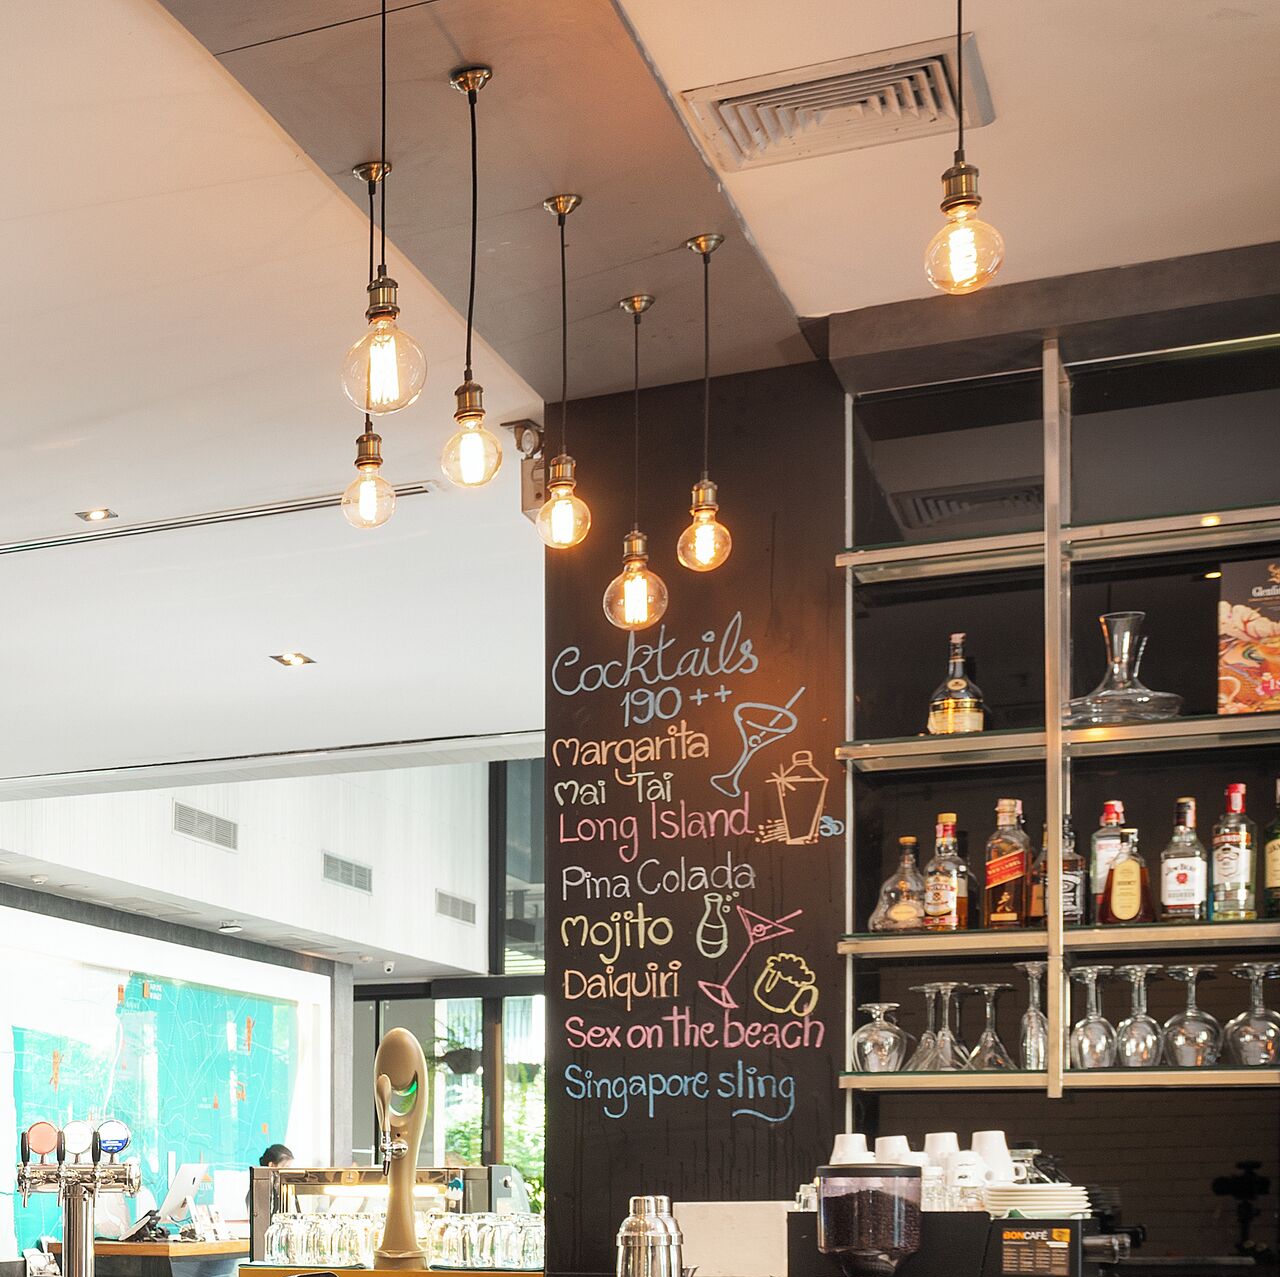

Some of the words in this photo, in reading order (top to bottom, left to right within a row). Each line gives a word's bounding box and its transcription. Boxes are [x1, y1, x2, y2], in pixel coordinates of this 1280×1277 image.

[551, 611, 759, 696] Cocktails
[634, 771, 674, 804] Tai
[558, 813, 639, 862] Long
[650, 791, 755, 841] Island
[561, 865, 631, 901] Pina
[637, 851, 756, 895] Colada
[563, 960, 682, 1011] Daiquiri
[564, 1015, 621, 1050] Sex
[627, 1023, 663, 1049] on
[662, 1006, 719, 1048] the
[723, 1003, 825, 1049] beach
[564, 1063, 710, 1119] Singapore
[717, 1060, 796, 1123] sling
